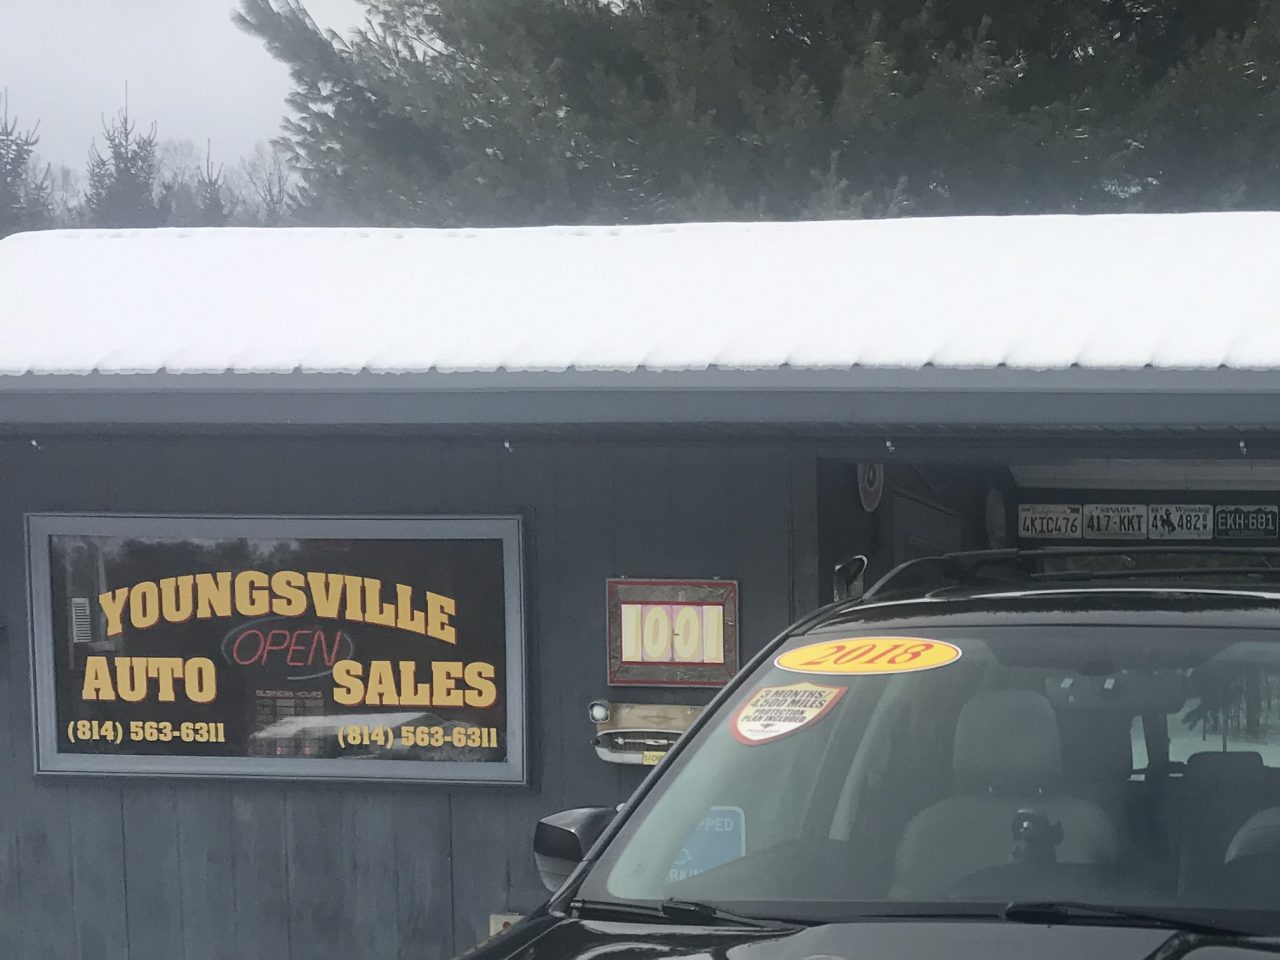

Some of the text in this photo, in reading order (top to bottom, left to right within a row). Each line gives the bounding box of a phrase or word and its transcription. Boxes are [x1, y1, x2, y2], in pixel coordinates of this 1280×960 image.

[1022, 516, 1078, 533] 4KIC476
[98, 571, 457, 645] YOUNGSVILLE
[233, 629, 342, 666] OPEN
[800, 643, 935, 667] 2018
[82, 656, 498, 707] AUTO SALES
[753, 708, 805, 716] PROTECTION
[786, 699, 827, 709] MILES
[67, 720, 226, 745] (814) 563-6311
[337, 724, 394, 749] (814)
[401, 726, 498, 748] 563-6311
